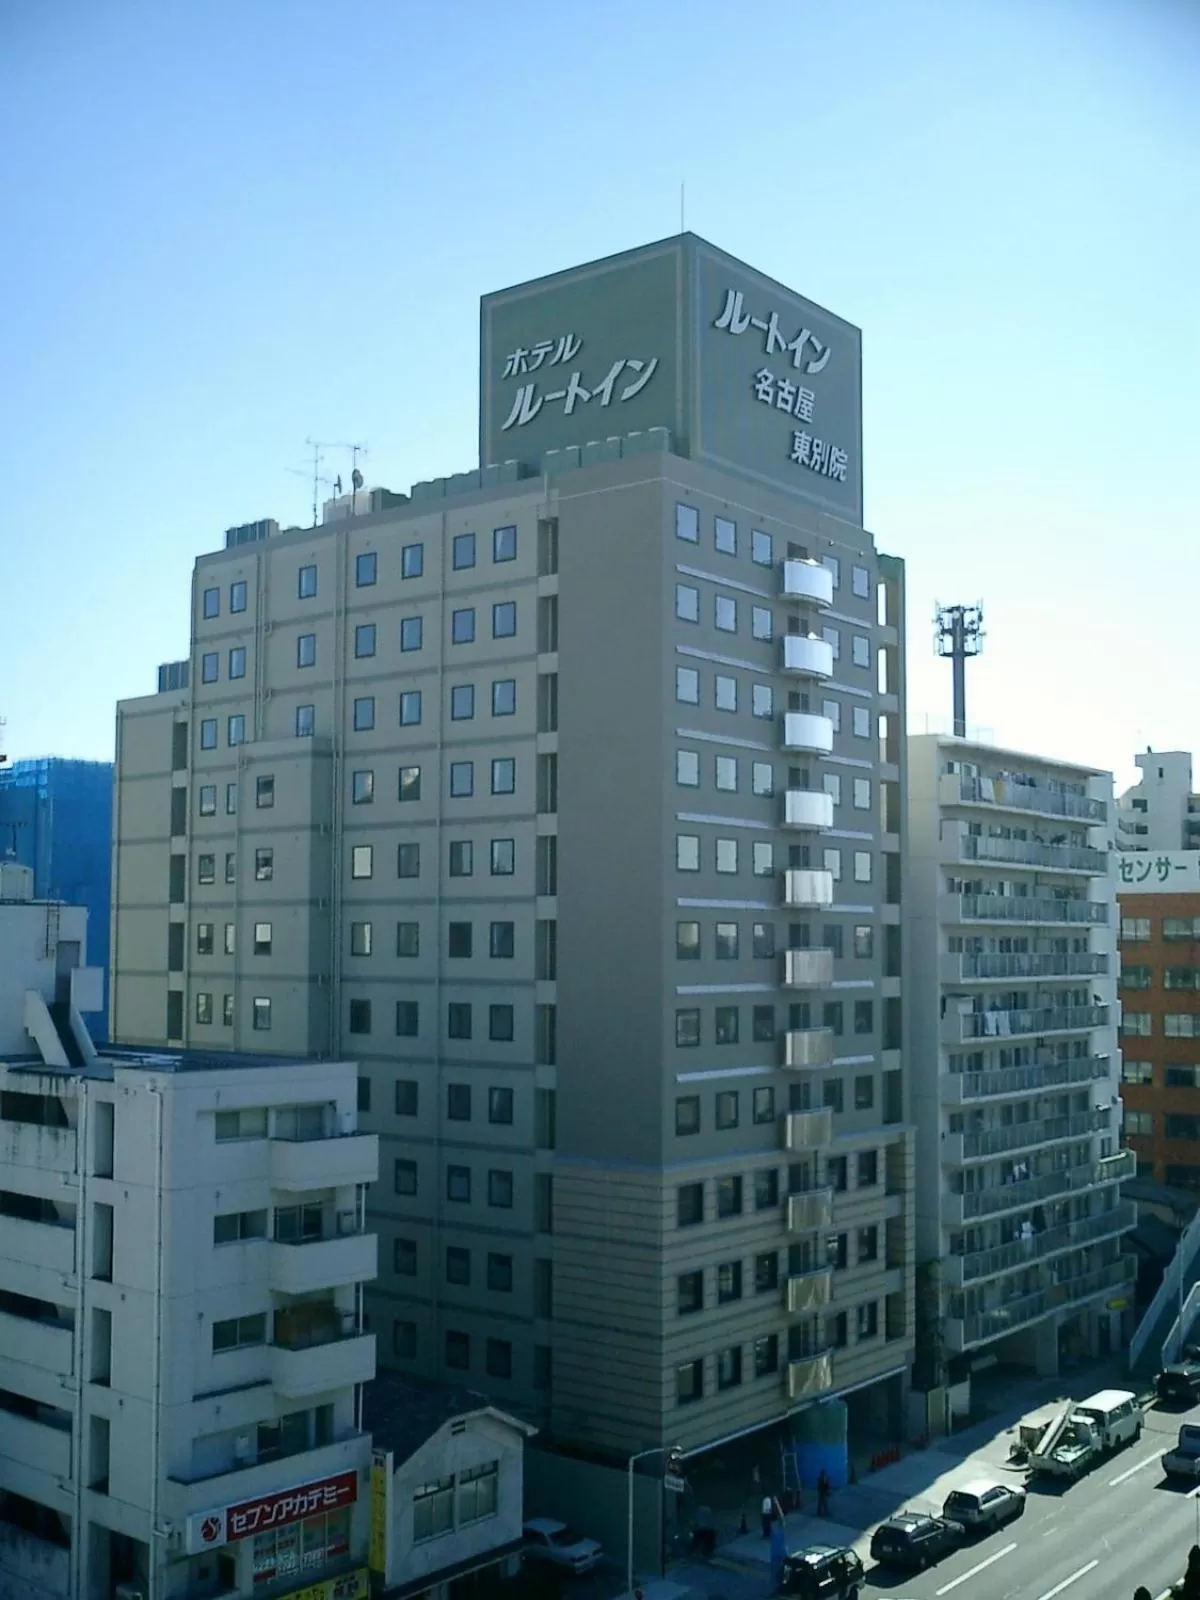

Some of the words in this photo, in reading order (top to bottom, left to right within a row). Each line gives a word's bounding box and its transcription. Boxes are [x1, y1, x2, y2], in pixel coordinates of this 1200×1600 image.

[502, 333, 583, 379] ホテル
[714, 288, 832, 374] ルートイン
[501, 357, 659, 431] ルートイン
[753, 367, 816, 423] 名古屋
[790, 430, 848, 482] 東別院
[1119, 856, 1187, 882] センサー
[230, 1485, 350, 1534] セブンアカデミー
